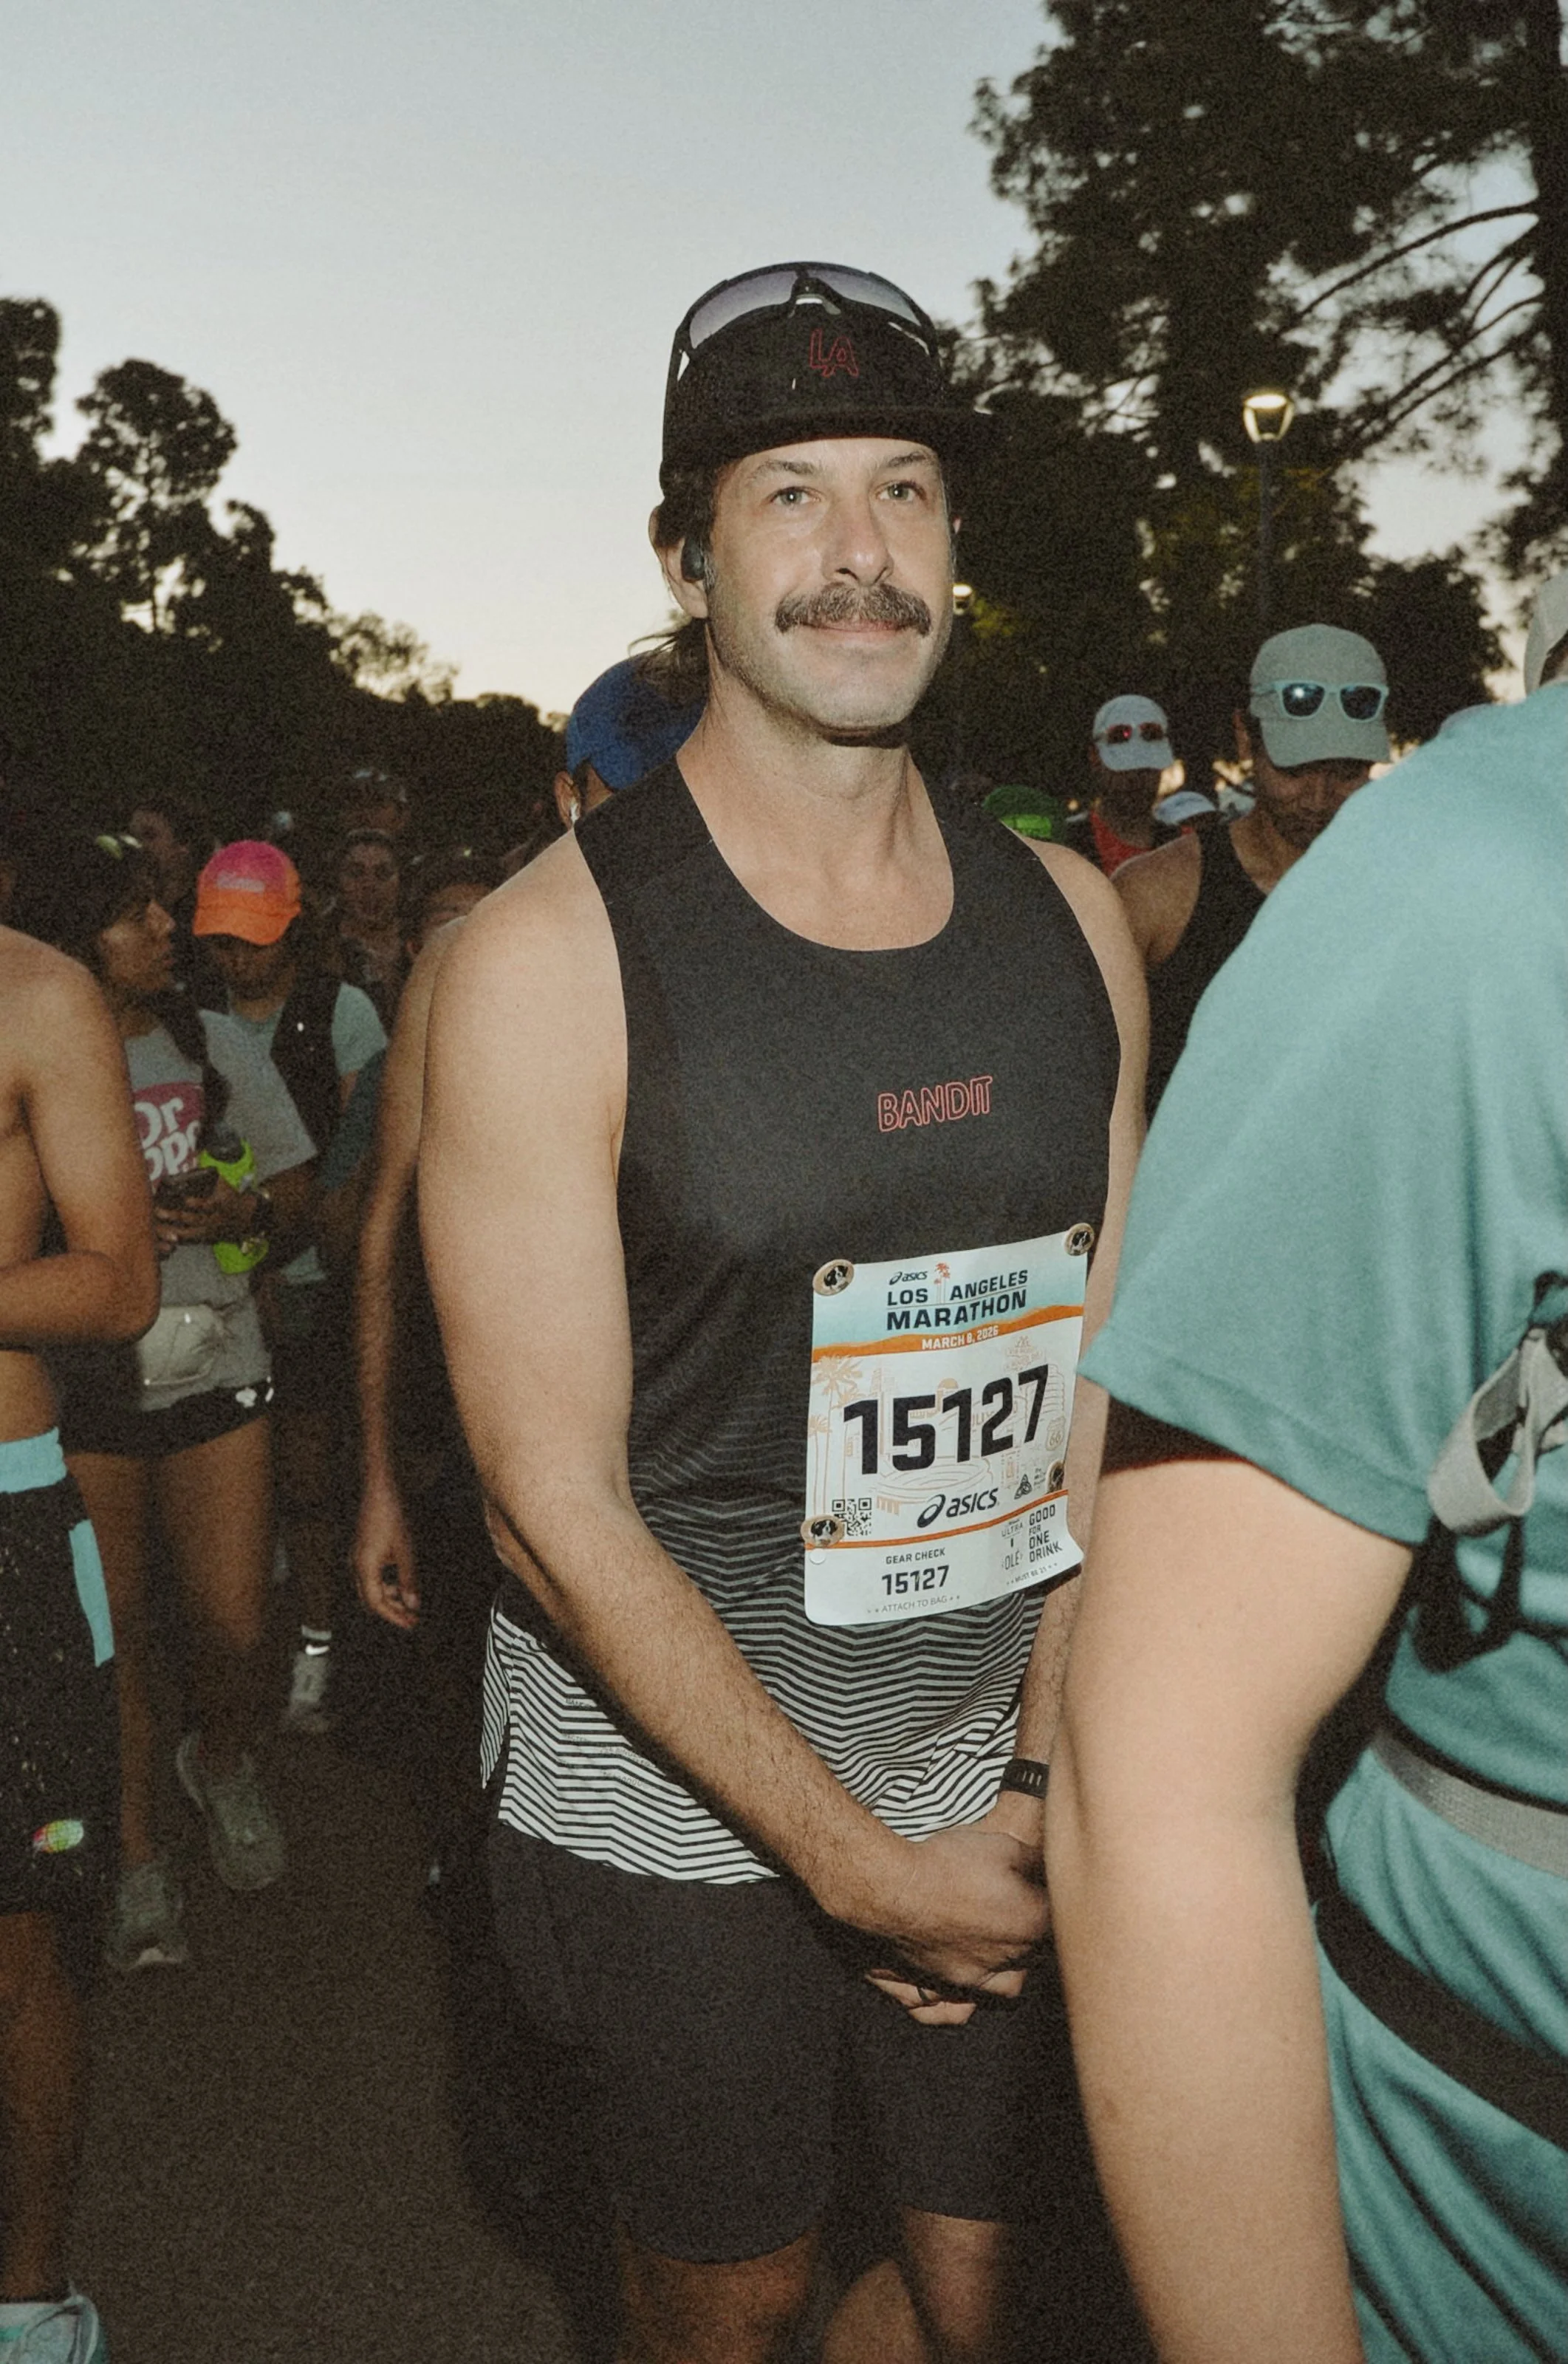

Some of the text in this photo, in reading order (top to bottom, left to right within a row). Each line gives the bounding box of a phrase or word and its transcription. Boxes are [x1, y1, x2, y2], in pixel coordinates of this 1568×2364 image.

[809, 328, 859, 378] LA
[877, 1076, 993, 1133] BANDIT
[887, 1270, 1028, 1306] LOS ANGELES
[887, 1289, 1027, 1330] MARATHON
[922, 1333, 965, 1350] MARCH
[976, 1325, 999, 1339] 2026
[843, 1364, 1049, 1475] 15127
[1029, 1504, 1055, 1526] GOOD
[1002, 1522, 1023, 1537] ULTRA
[1029, 1524, 1041, 1536] FOR
[1029, 1530, 1050, 1549] ONE
[886, 1548, 945, 1565] GEAR CHECK
[1029, 1541, 1063, 1562] DRINK
[882, 1565, 949, 1596] 15127
[882, 1595, 947, 1613] ATTACH TO BAG
